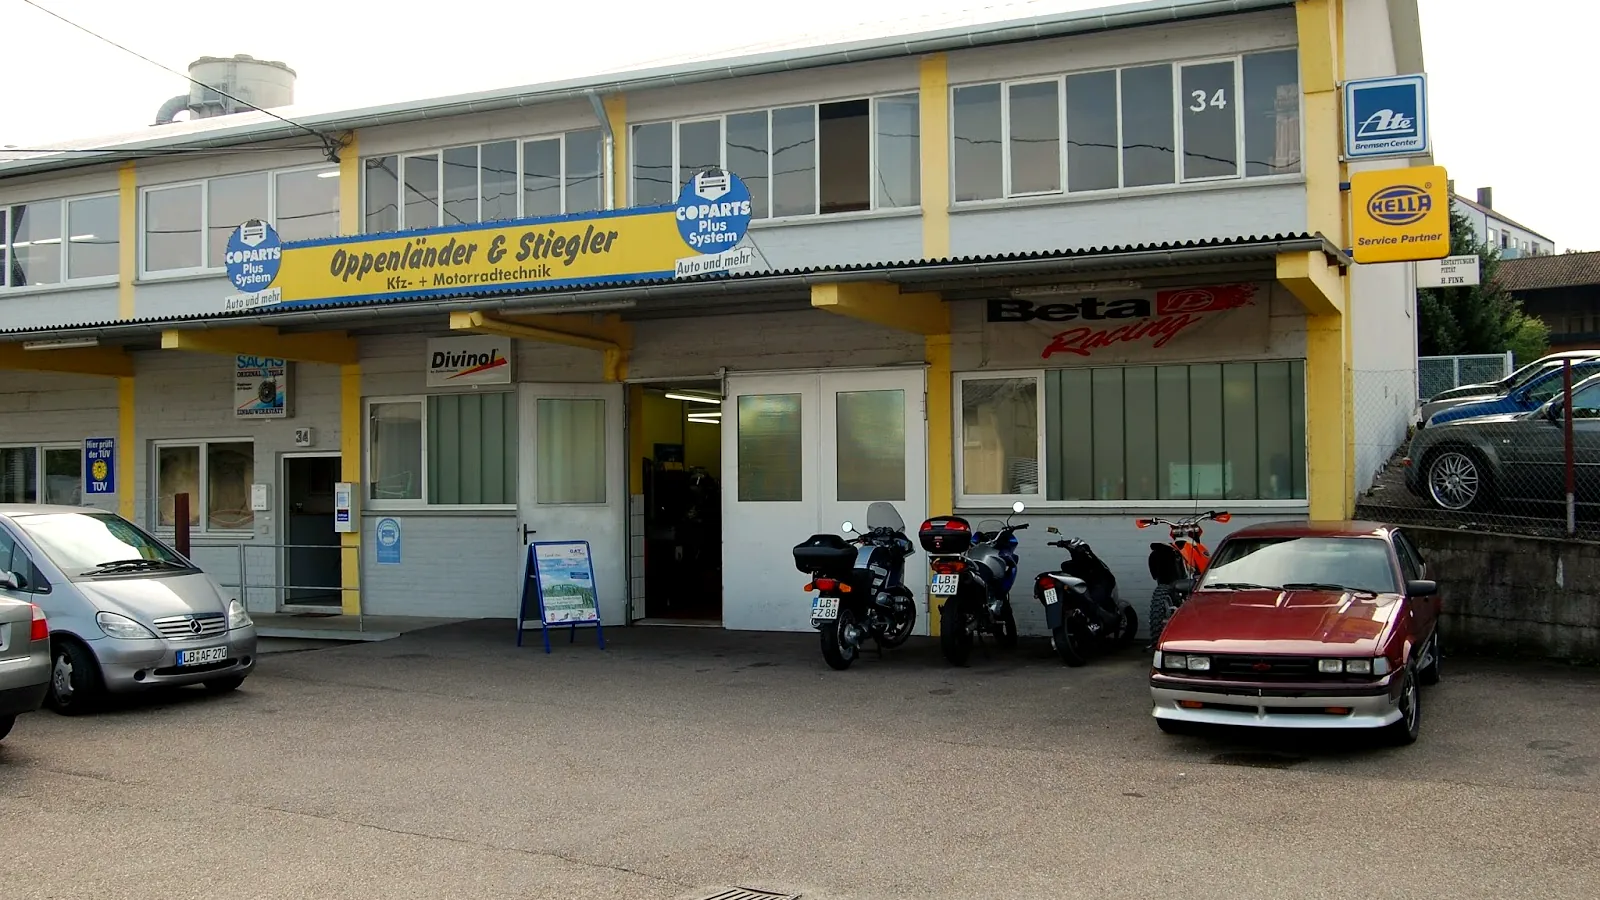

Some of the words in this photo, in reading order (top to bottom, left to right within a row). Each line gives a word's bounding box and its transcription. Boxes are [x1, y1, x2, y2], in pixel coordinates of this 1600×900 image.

[1190, 88, 1227, 112] 34
[1357, 109, 1414, 137] Ate
[1355, 140, 1389, 150] Bremsen
[1390, 138, 1418, 148] Center
[676, 200, 751, 221] COPARTS
[1372, 193, 1432, 213] HELLA
[699, 220, 727, 232] Plus
[689, 231, 737, 247] System
[1358, 235, 1398, 247] Service
[1401, 232, 1443, 244] Partner
[226, 246, 281, 264] COPARTS
[330, 235, 478, 283] Oppenländer
[487, 234, 508, 265] &
[515, 224, 619, 266] Stiegler
[242, 262, 264, 275] Plus
[676, 261, 700, 276] Auto
[703, 254, 721, 268] und
[724, 250, 751, 267] mehr
[235, 273, 271, 287] System
[386, 276, 413, 290] Kfz-
[433, 263, 551, 287] Motorradtechnik
[1448, 276, 1464, 284] FINK
[225, 299, 244, 310] Auto
[245, 293, 260, 305] und
[261, 289, 280, 303] mehr
[987, 297, 1151, 323] Beta
[1041, 314, 1202, 359] Racing
[236, 354, 284, 369] SACHS
[431, 348, 497, 369] Divinol
[295, 430, 309, 443] 34
[86, 441, 98, 449] Hier
[88, 450, 98, 459] der
[98, 447, 111, 458] TÜV
[938, 575, 951, 584] LB
[819, 599, 832, 608] LB
